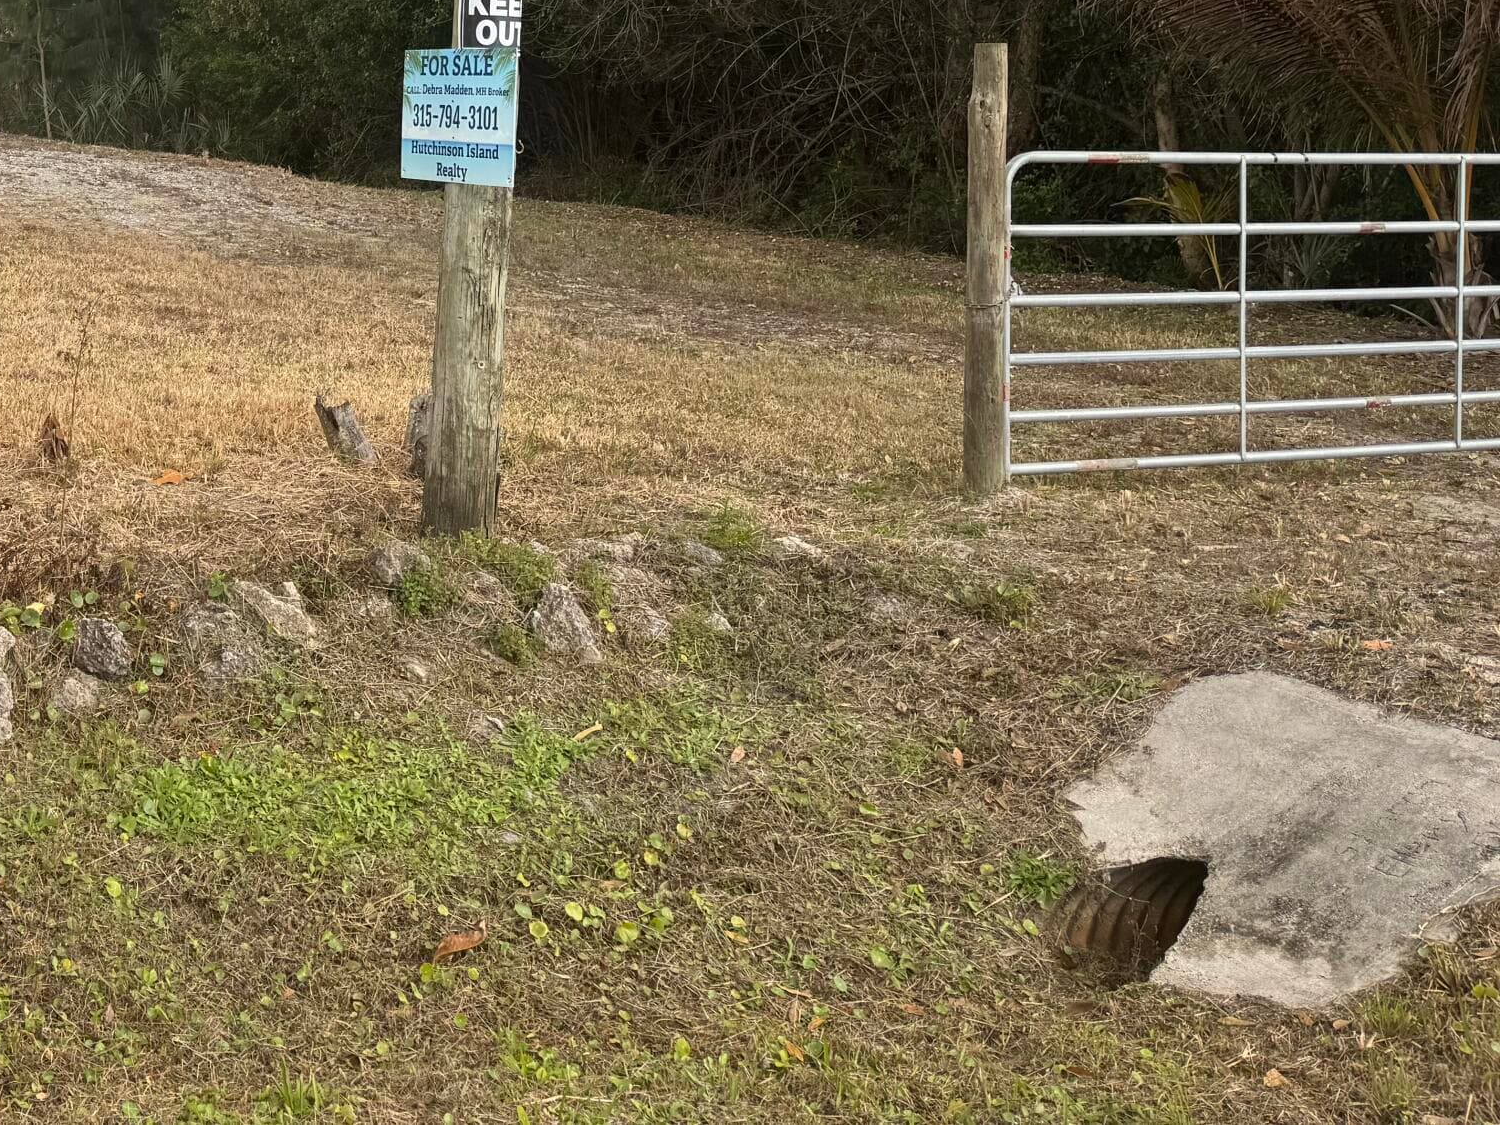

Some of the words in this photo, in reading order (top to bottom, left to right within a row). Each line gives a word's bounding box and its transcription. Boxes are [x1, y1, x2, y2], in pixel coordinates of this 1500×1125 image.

[420, 55, 449, 76] FOR
[452, 55, 493, 76] SALE
[422, 84, 442, 95] Debra
[475, 87, 487, 96] MH
[488, 87, 510, 97] Broker
[412, 103, 498, 130] 315-794-3101
[411, 140, 464, 157] Hutchinson
[466, 143, 499, 159] Island
[436, 162, 467, 182] Realty
